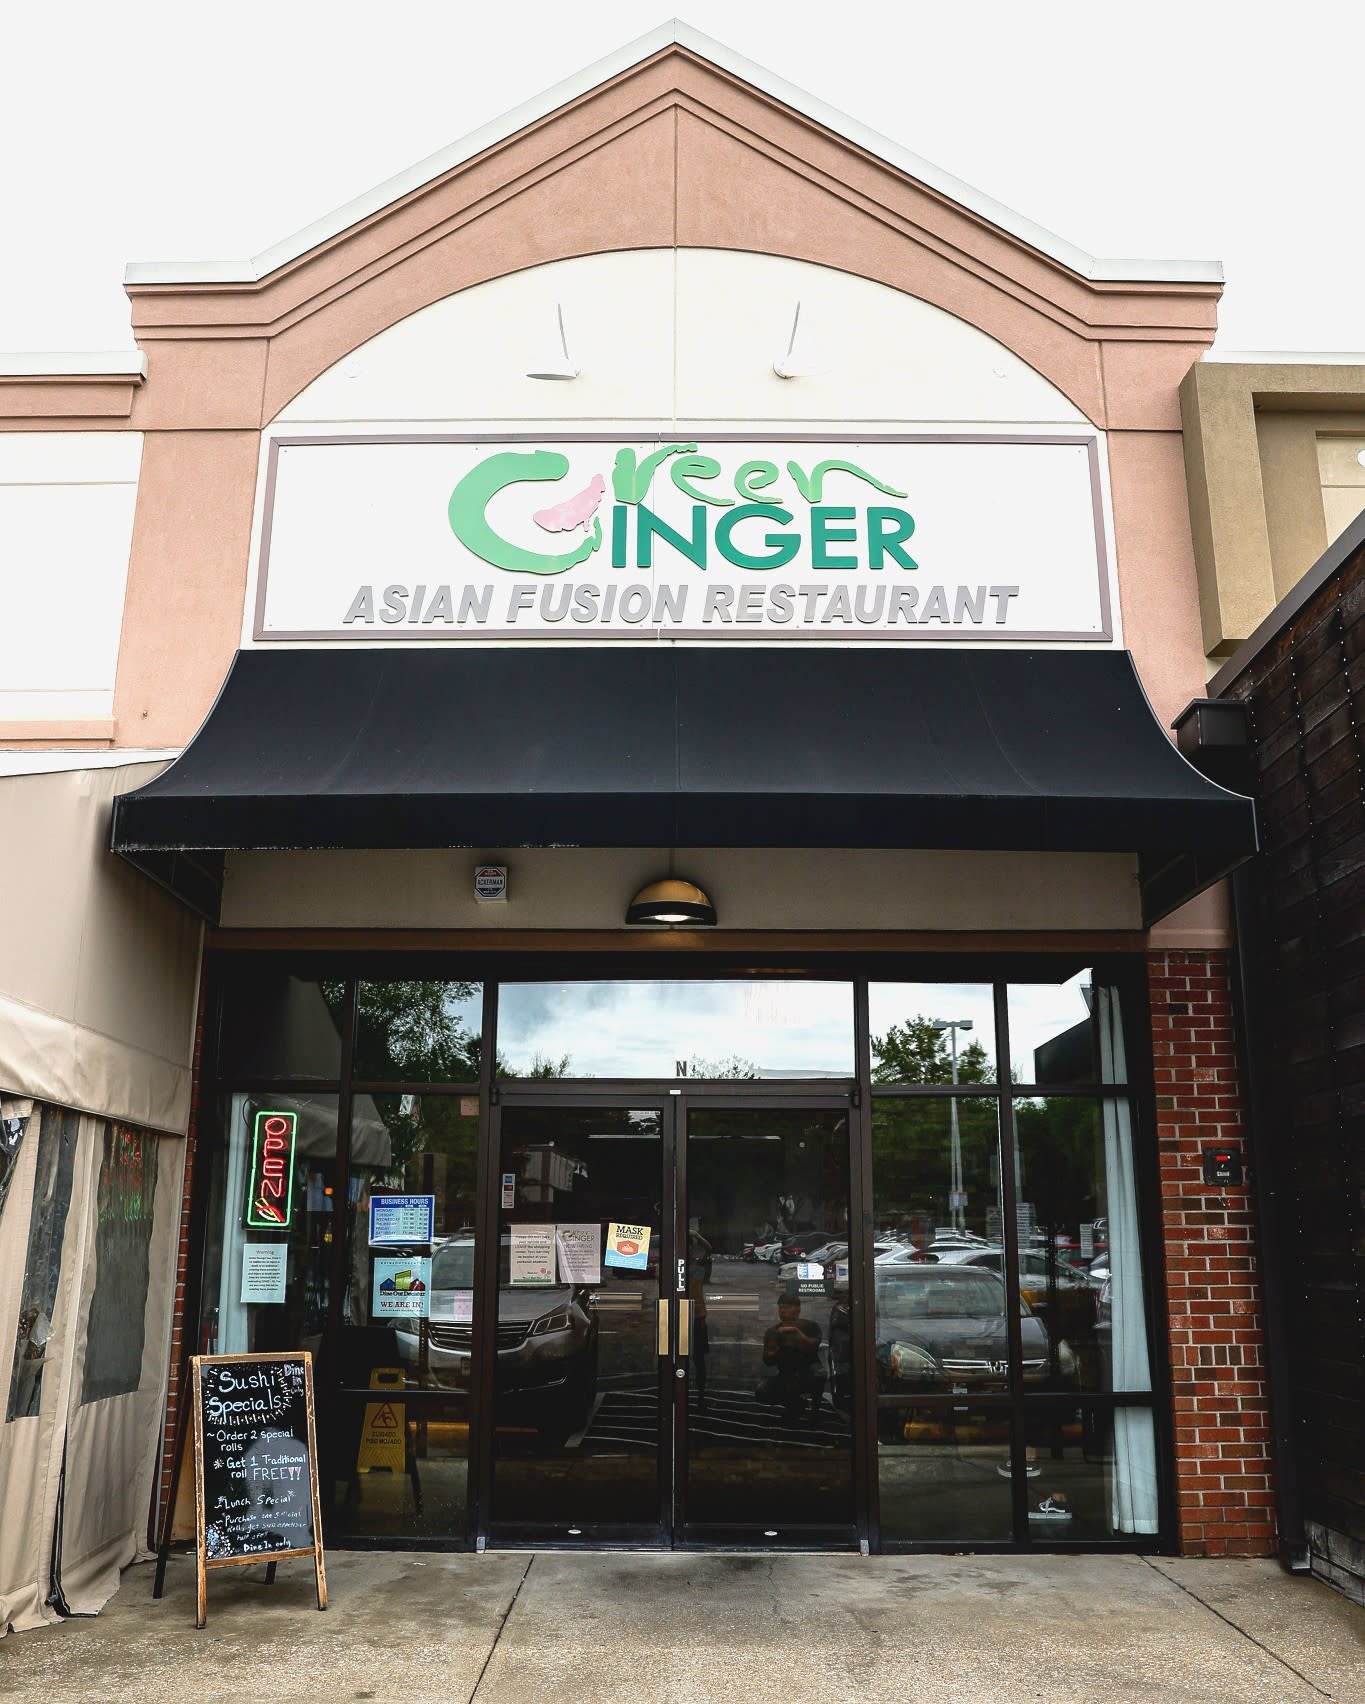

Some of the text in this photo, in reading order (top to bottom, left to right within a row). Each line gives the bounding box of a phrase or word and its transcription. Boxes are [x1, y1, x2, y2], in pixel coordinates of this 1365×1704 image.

[343, 583, 1020, 624] ASIAN FUSION RESTAURANT
[261, 1117, 287, 1198] OPEN
[616, 1225, 643, 1236] MASK
[615, 1233, 643, 1241] REQUIRED
[284, 1364, 304, 1377] Dine
[218, 1371, 275, 1393] Sushi
[209, 1389, 281, 1424] Specials
[216, 1429, 247, 1441] Order
[250, 1430, 258, 1439] 2
[220, 1443, 243, 1451] rolls
[226, 1454, 306, 1469] Get 1 Traditional
[231, 1469, 247, 1478] roll
[224, 1498, 251, 1509] Lunch
